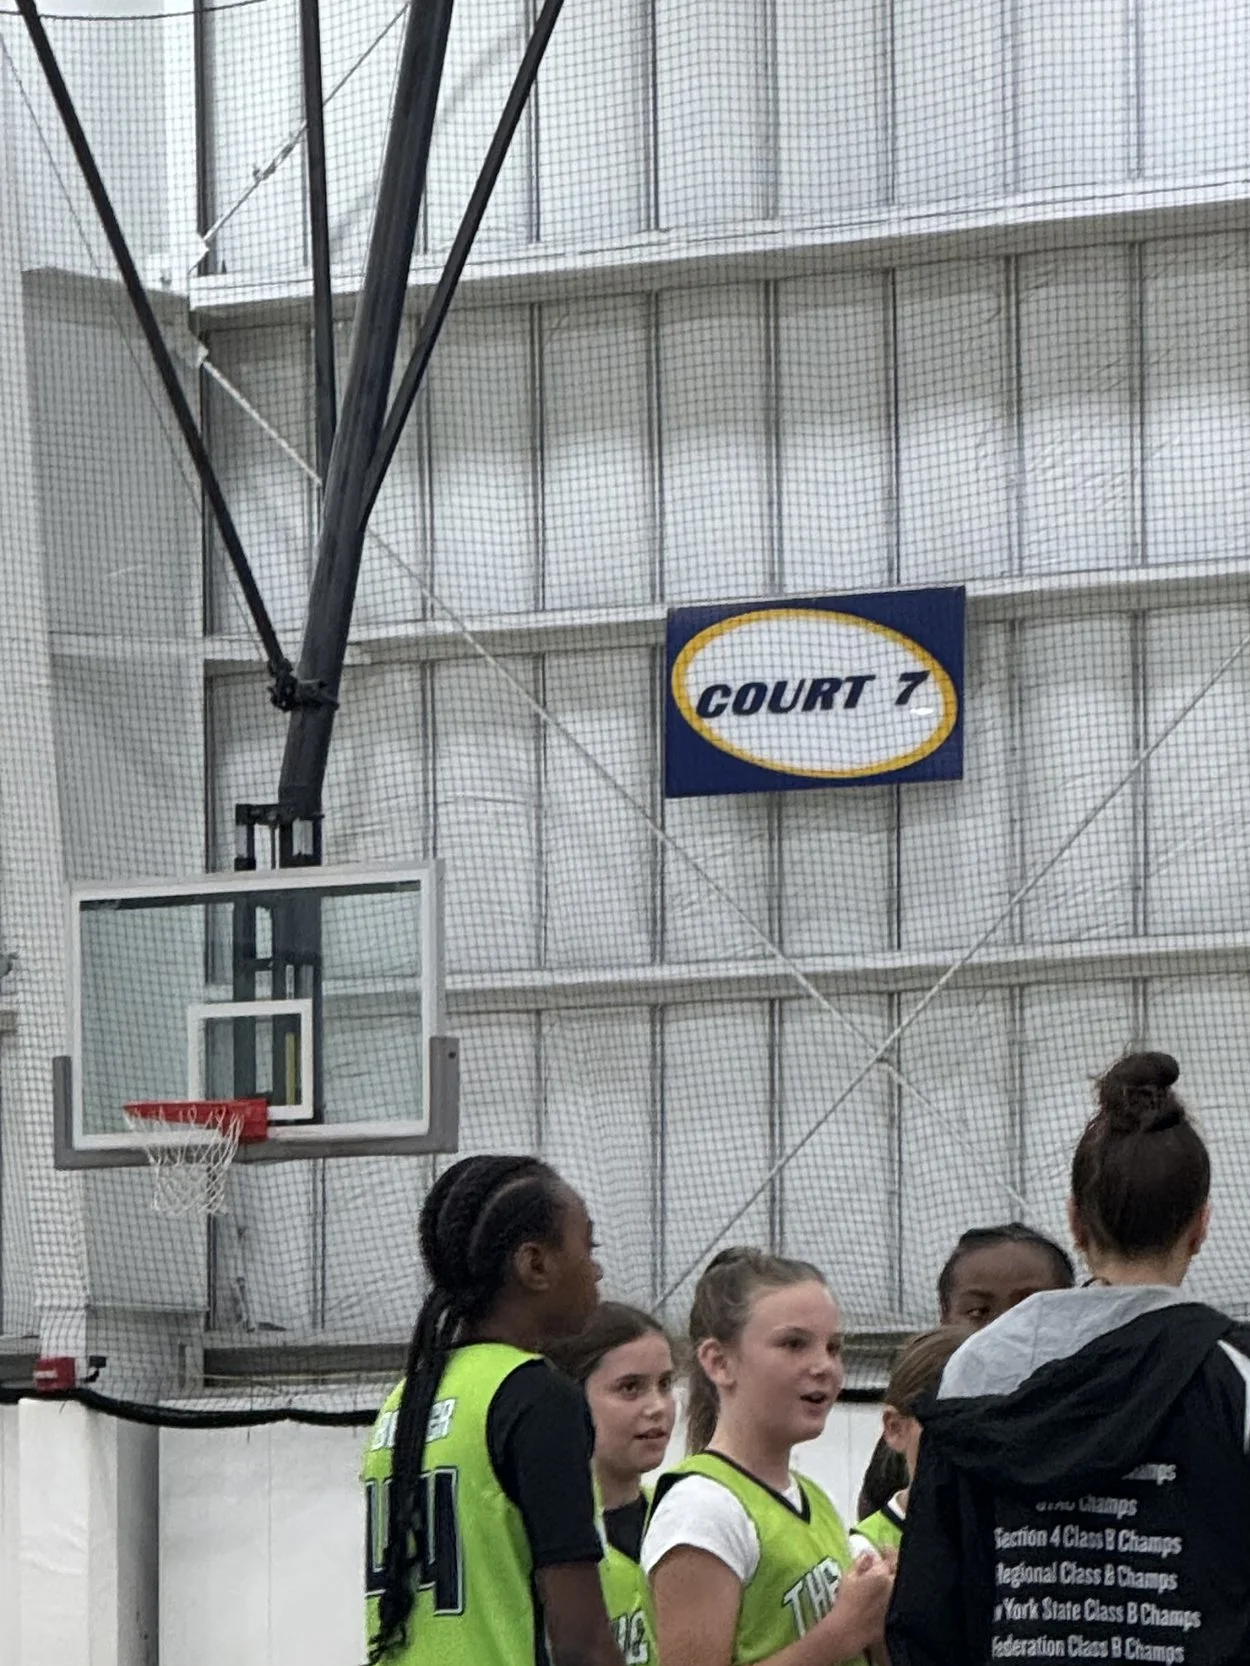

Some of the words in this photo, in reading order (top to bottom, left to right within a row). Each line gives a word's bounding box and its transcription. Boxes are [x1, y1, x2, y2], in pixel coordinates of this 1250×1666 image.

[695, 674, 875, 719] COURT
[894, 669, 931, 705] 7
[994, 1526, 1048, 1549] Section
[1049, 1525, 1062, 1548] 4
[1063, 1525, 1103, 1549] Class
[1118, 1529, 1182, 1558] Champs
[1059, 1561, 1101, 1585] Class
[1117, 1564, 1178, 1594] Champs
[1003, 1597, 1039, 1622] York
[1041, 1596, 1081, 1622] State
[1083, 1598, 1124, 1624] Class
[1127, 1602, 1138, 1625] B
[1140, 1602, 1202, 1632] Champs
[1067, 1635, 1109, 1659] Class
[1111, 1637, 1122, 1660] B
[1125, 1637, 1184, 1666] Champs
